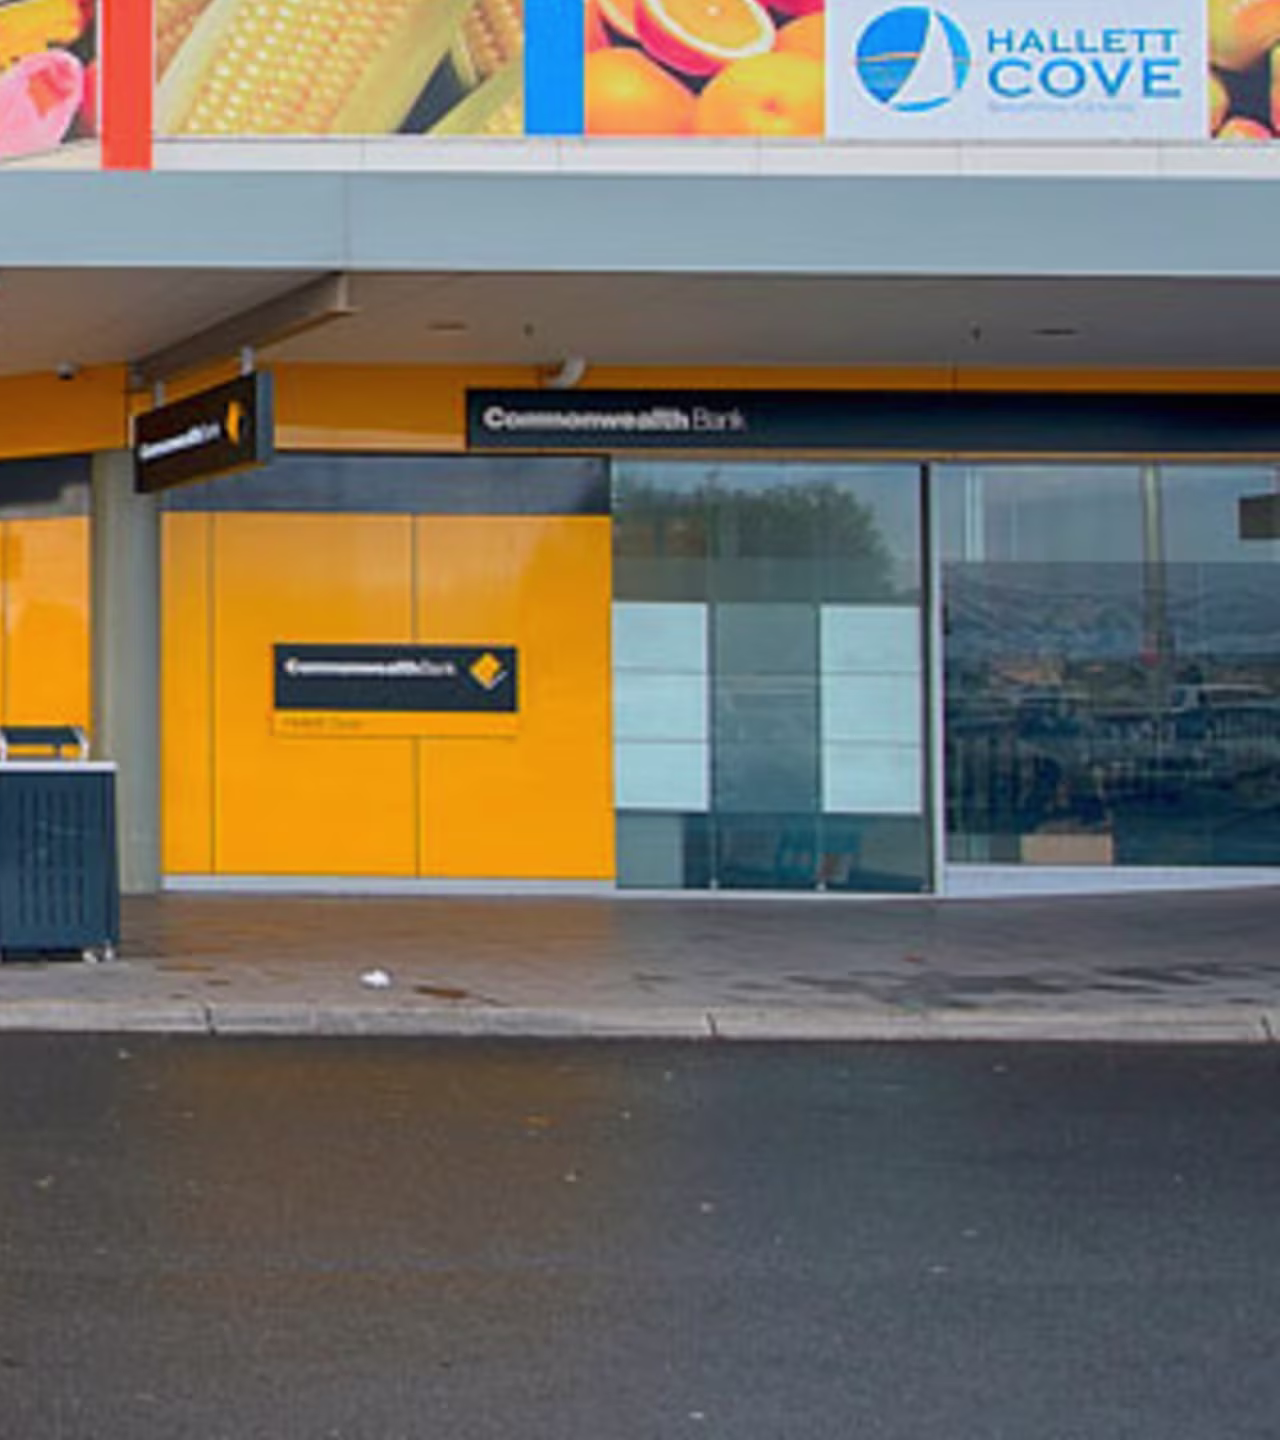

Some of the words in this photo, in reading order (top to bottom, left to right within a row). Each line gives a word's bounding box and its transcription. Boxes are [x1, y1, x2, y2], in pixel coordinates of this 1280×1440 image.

[987, 28, 1180, 53] HALLETT
[988, 57, 1182, 98] COVE
[483, 406, 690, 431] Commonwealth
[692, 407, 748, 431] Bank
